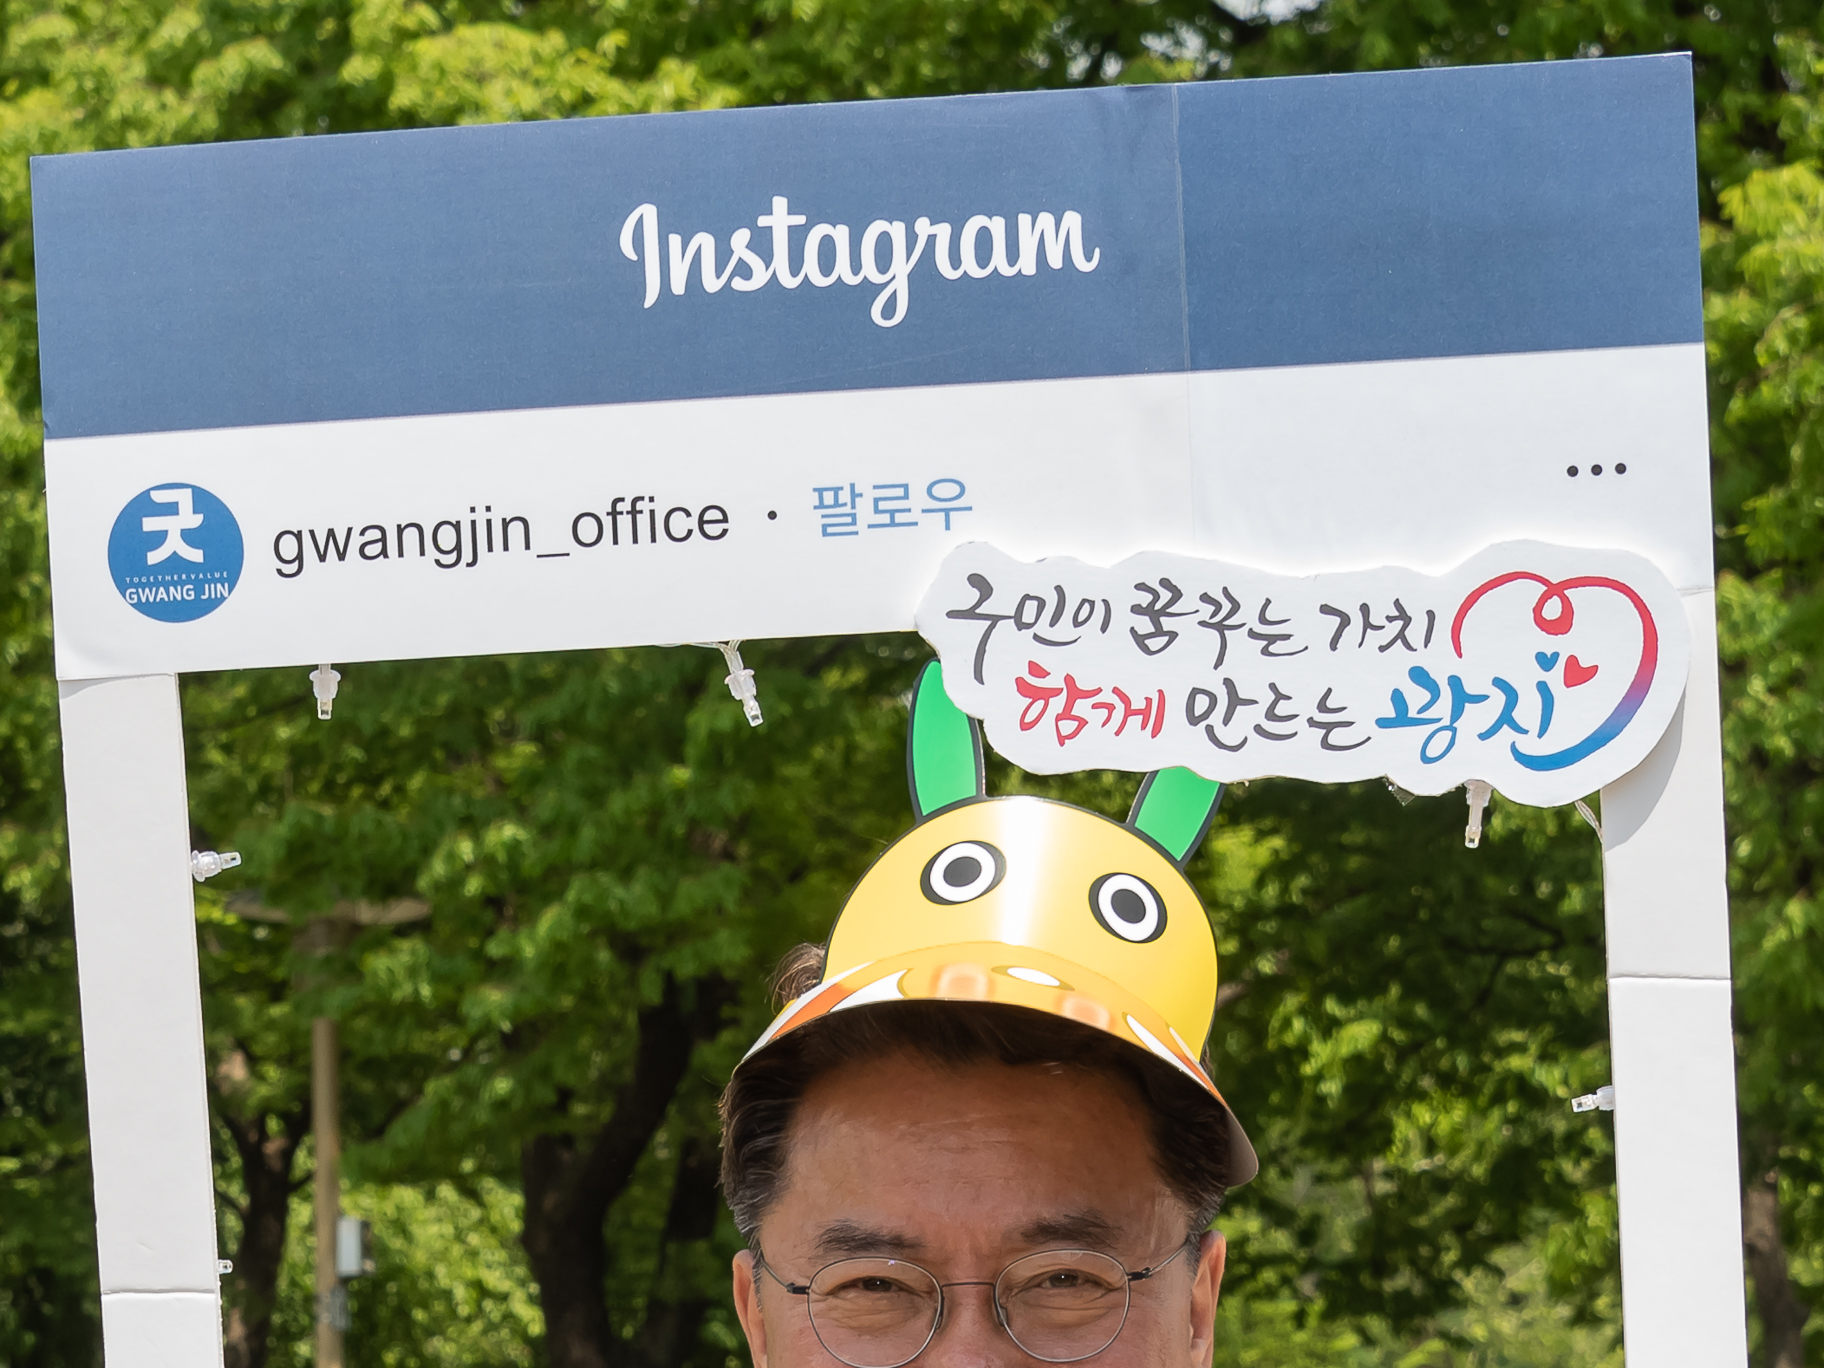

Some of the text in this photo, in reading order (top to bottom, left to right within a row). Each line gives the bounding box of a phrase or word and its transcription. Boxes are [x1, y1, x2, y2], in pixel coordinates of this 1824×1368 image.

[620, 196, 1099, 327] Instagram
[274, 479, 972, 578] gwangjin_office 팔로우
[125, 582, 230, 604] GWANG JIN
[946, 573, 1435, 685] 구민이 꿈꾸는 가치
[1015, 661, 1165, 747] 함께
[1186, 678, 1371, 752] 만드는
